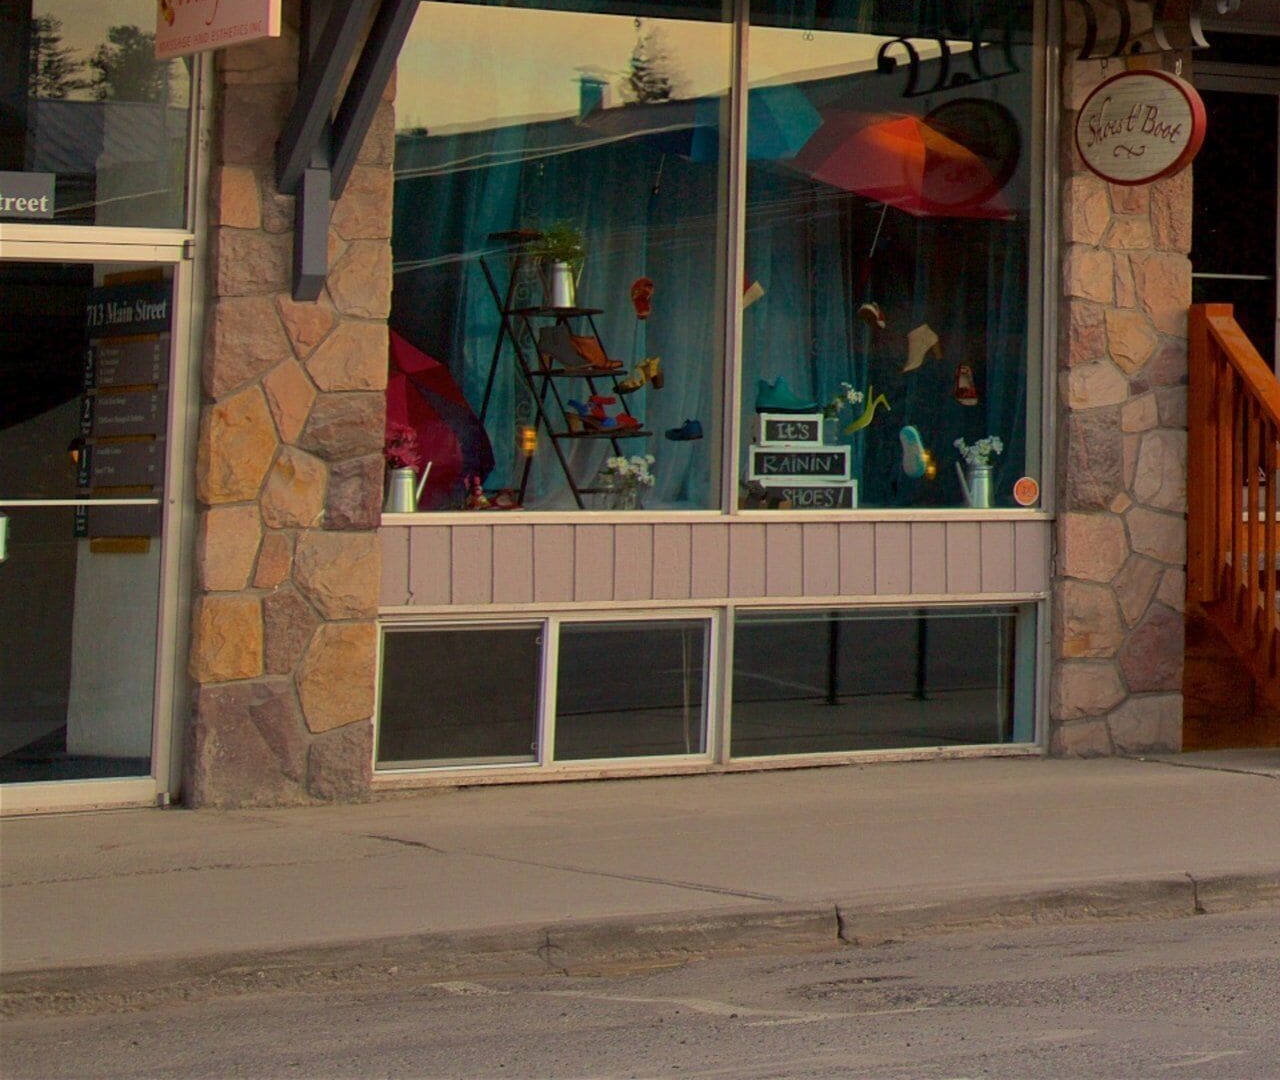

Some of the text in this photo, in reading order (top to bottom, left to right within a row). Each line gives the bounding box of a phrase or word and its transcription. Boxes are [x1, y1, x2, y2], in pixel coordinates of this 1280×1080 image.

[1142, 105, 1182, 143] Boot
[87, 297, 167, 326] 713 Main Street
[776, 422, 810, 440] It's
[763, 454, 839, 474] RAININ'
